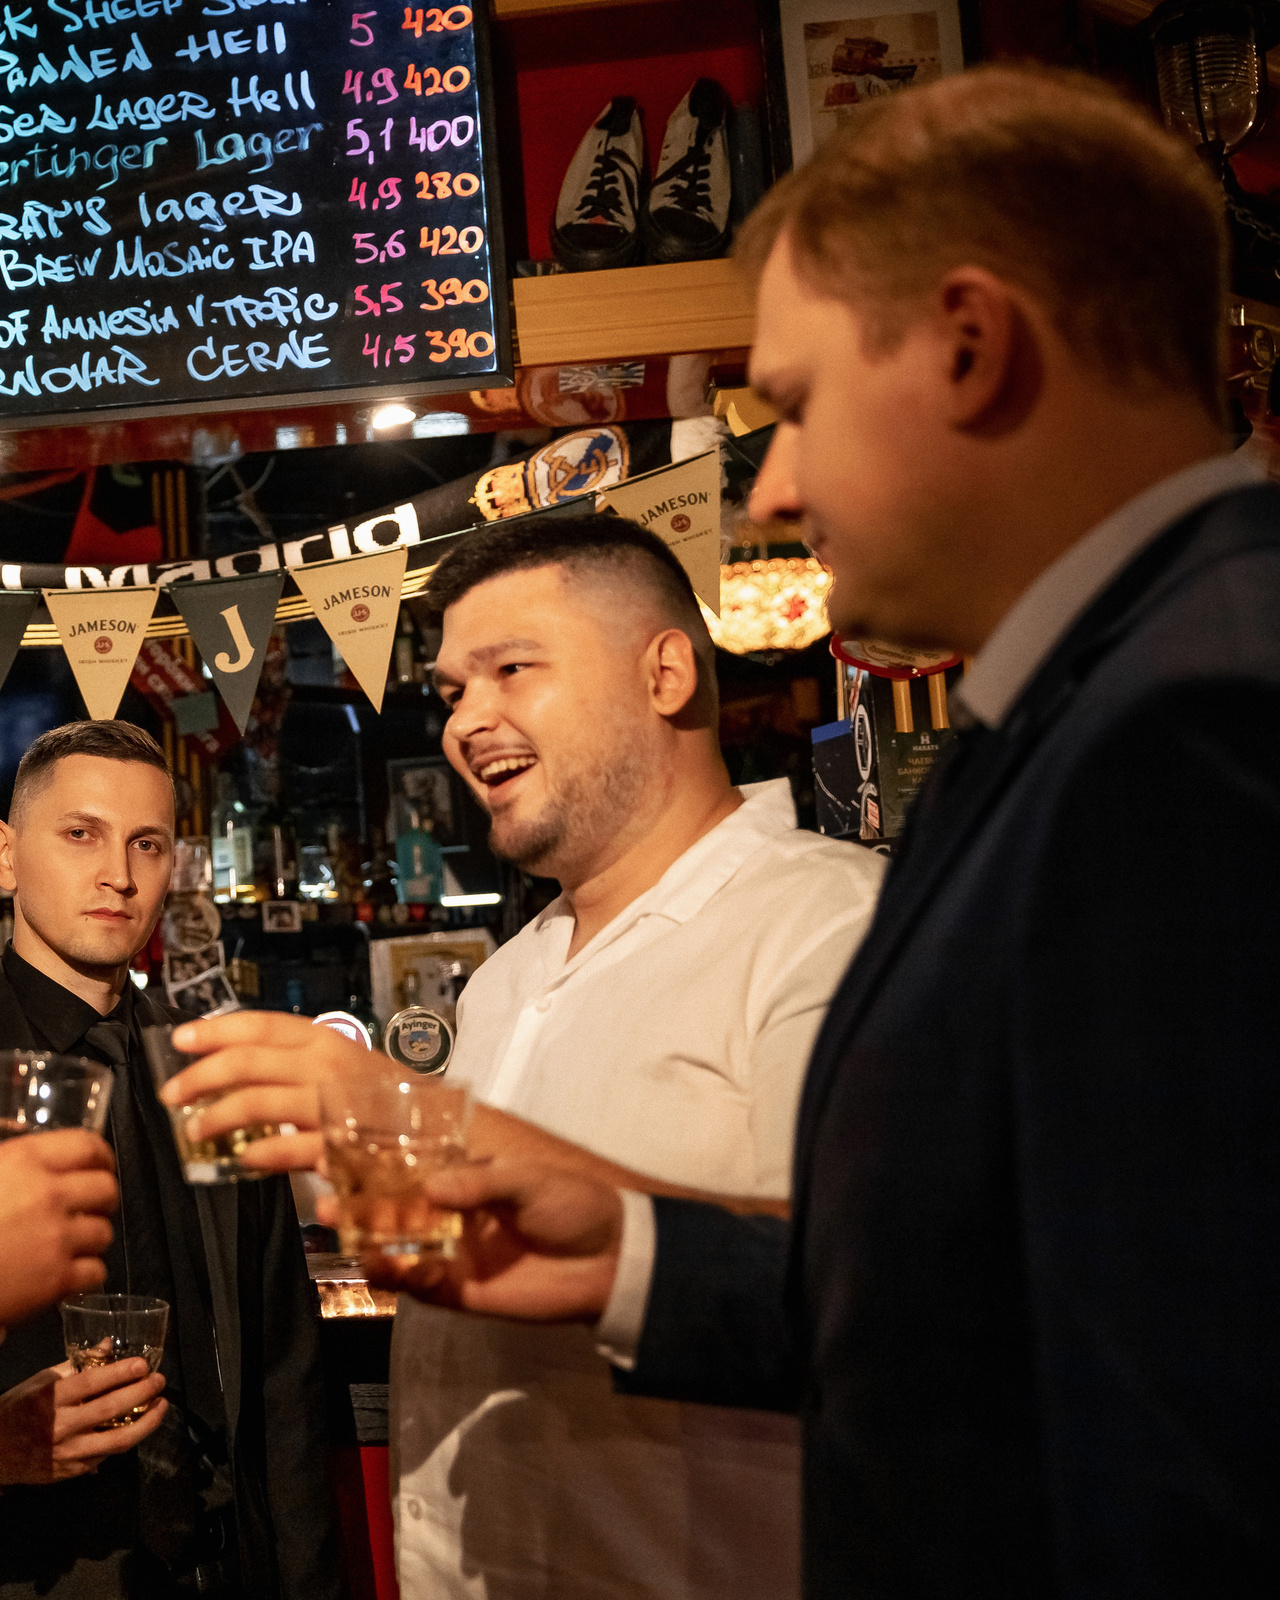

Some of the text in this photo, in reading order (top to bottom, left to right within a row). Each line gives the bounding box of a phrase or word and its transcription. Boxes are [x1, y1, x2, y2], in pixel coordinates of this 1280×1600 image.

[349, 11, 378, 47] 5
[402, 4, 473, 38] 420
[342, 67, 399, 105] 4,9
[404, 63, 471, 97] 420
[194, 122, 323, 174] Lager
[346, 117, 394, 165] 5,1
[409, 115, 474, 153] 400
[348, 177, 402, 210] 4,9
[415, 171, 480, 200] 280
[242, 230, 315, 270] IPA
[352, 229, 406, 264] 5,6
[419, 225, 484, 257] 420
[354, 281, 404, 316] 5,5
[419, 277, 489, 311] 390
[186, 330, 332, 382] CERNE
[362, 333, 417, 368] 4,5
[425, 328, 495, 363] 390
[641, 491, 708, 526] JAMESON
[64, 503, 421, 589] Madrid
[323, 585, 391, 610] JAMESON
[69, 619, 137, 637] JAMESON
[214, 604, 256, 673] J
[401, 1018, 438, 1031] Ayinger
